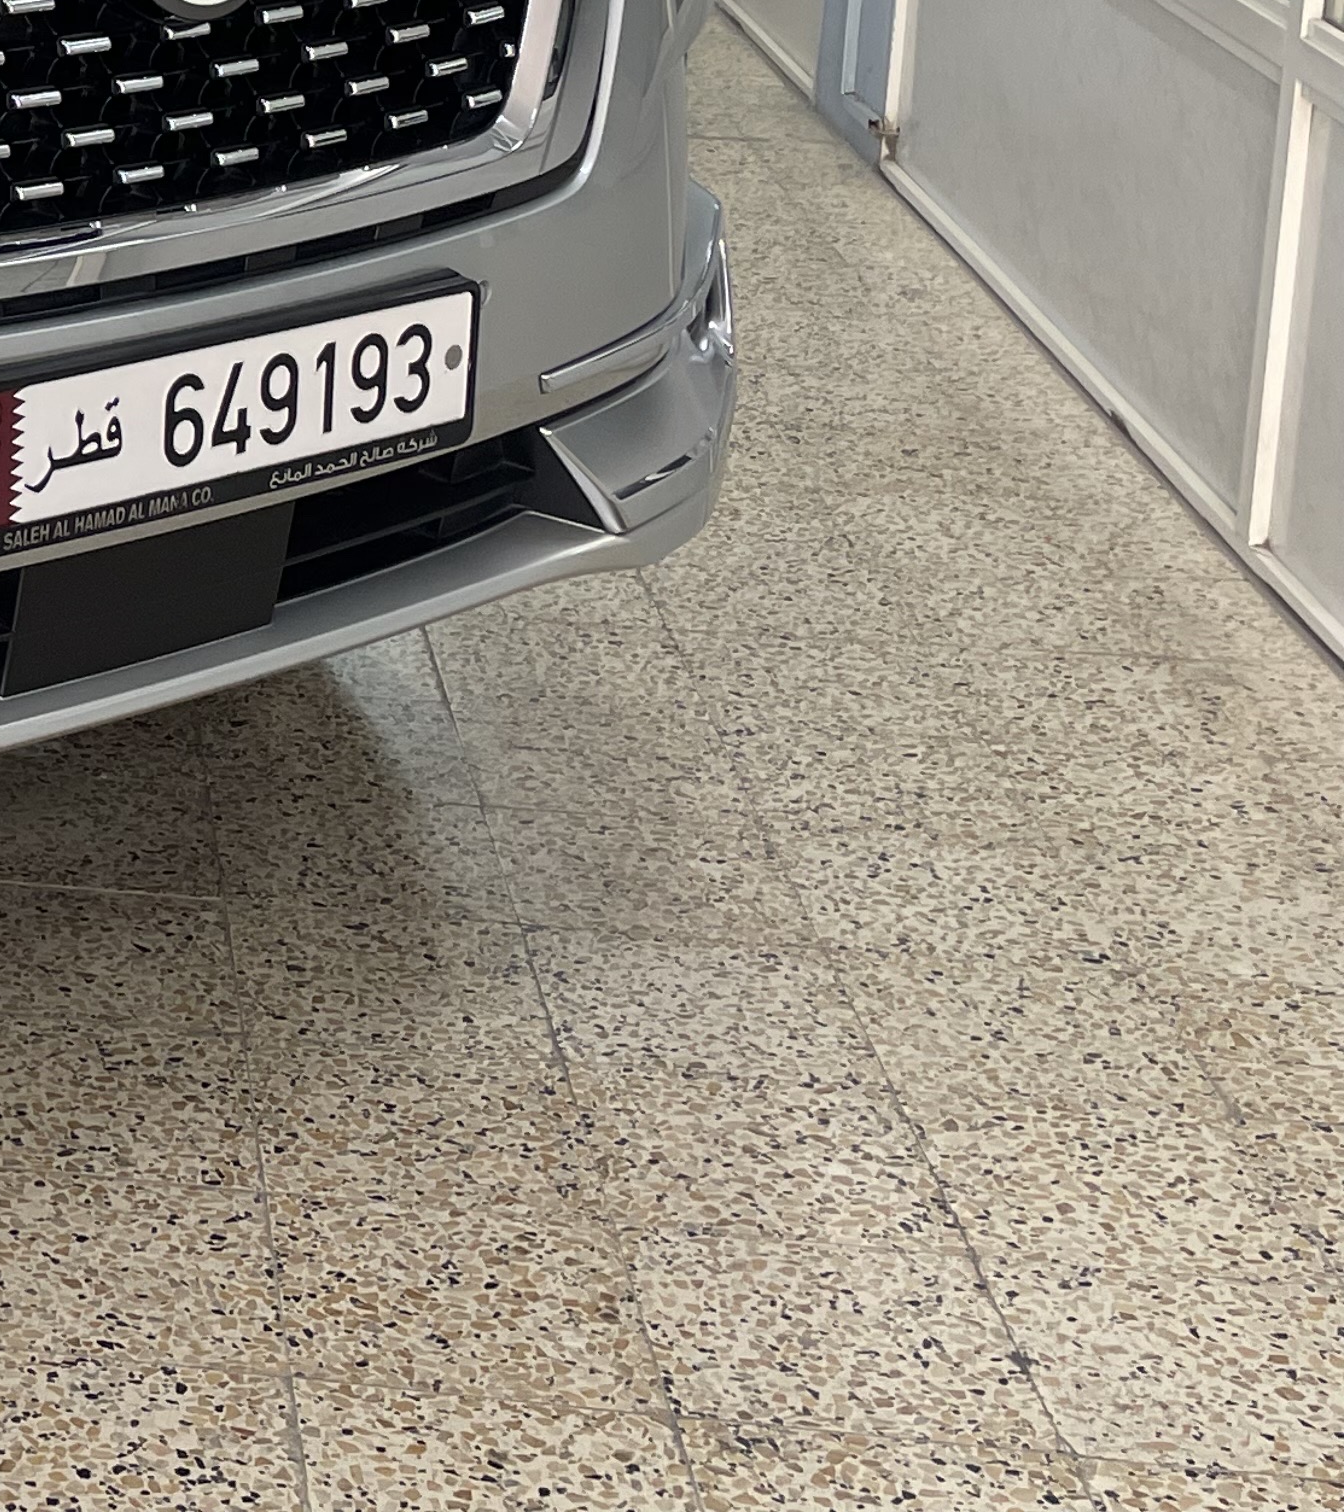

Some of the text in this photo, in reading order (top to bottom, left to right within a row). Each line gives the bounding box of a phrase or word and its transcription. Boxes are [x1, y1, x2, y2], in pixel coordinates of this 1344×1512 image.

[163, 323, 433, 468] 649193
[24, 397, 123, 494] قطر
[314, 452, 358, 476] الحمد
[359, 446, 394, 467] صالح
[269, 463, 312, 489] المانع
[3, 523, 50, 551] SALEH
[52, 521, 70, 541] AL
[75, 508, 126, 536] HAMAD
[129, 502, 145, 520] AL
[191, 486, 213, 507] CO.
